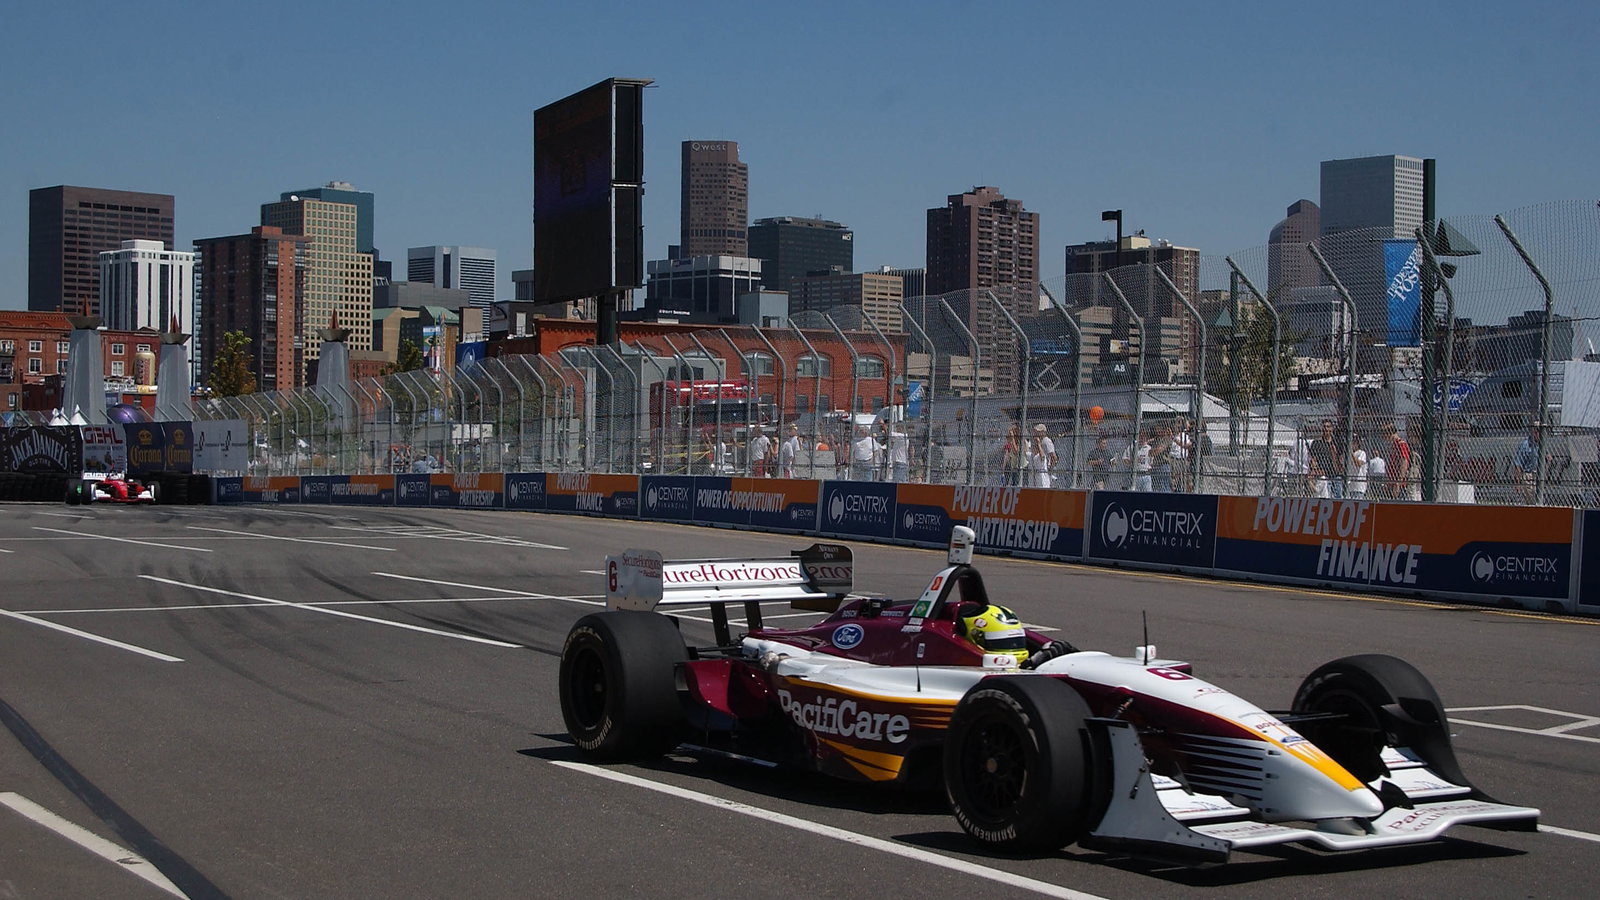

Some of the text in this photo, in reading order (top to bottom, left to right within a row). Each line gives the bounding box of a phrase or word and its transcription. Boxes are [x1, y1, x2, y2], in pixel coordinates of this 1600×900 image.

[692, 142, 727, 151] Qwest
[1114, 364, 1126, 373] A8
[84, 426, 124, 445] GEHL
[10, 437, 33, 470] JACK
[32, 429, 70, 470] DANIEL'S
[129, 444, 162, 467] Corona
[518, 482, 543, 494] CENTRIX
[556, 471, 591, 491] POWER OF
[575, 491, 604, 511] FINANCE
[657, 486, 689, 502] CENTRIX
[697, 488, 787, 513] POWER OF OPPORTUNITY
[845, 494, 889, 514] CENTRIX
[952, 486, 1022, 515] POWER OF
[844, 513, 887, 524] FINANCIAL
[914, 513, 941, 526] CENTRIX
[1130, 510, 1204, 536] CENTRIX
[1253, 497, 1371, 539] POWER OF
[967, 516, 1060, 551] PARTNERSHIP
[1129, 534, 1201, 549] FINANCIAL
[1316, 538, 1423, 584] FINANCE
[1496, 556, 1558, 573] CENTRIX
[609, 560, 618, 593] 6
[663, 563, 802, 583] ureHorizons
[1495, 572, 1556, 583] FINANCIAL
[1146, 667, 1194, 681] 6
[777, 688, 911, 745] PacifiCare
[953, 803, 1017, 842] BRIDGESTONE
